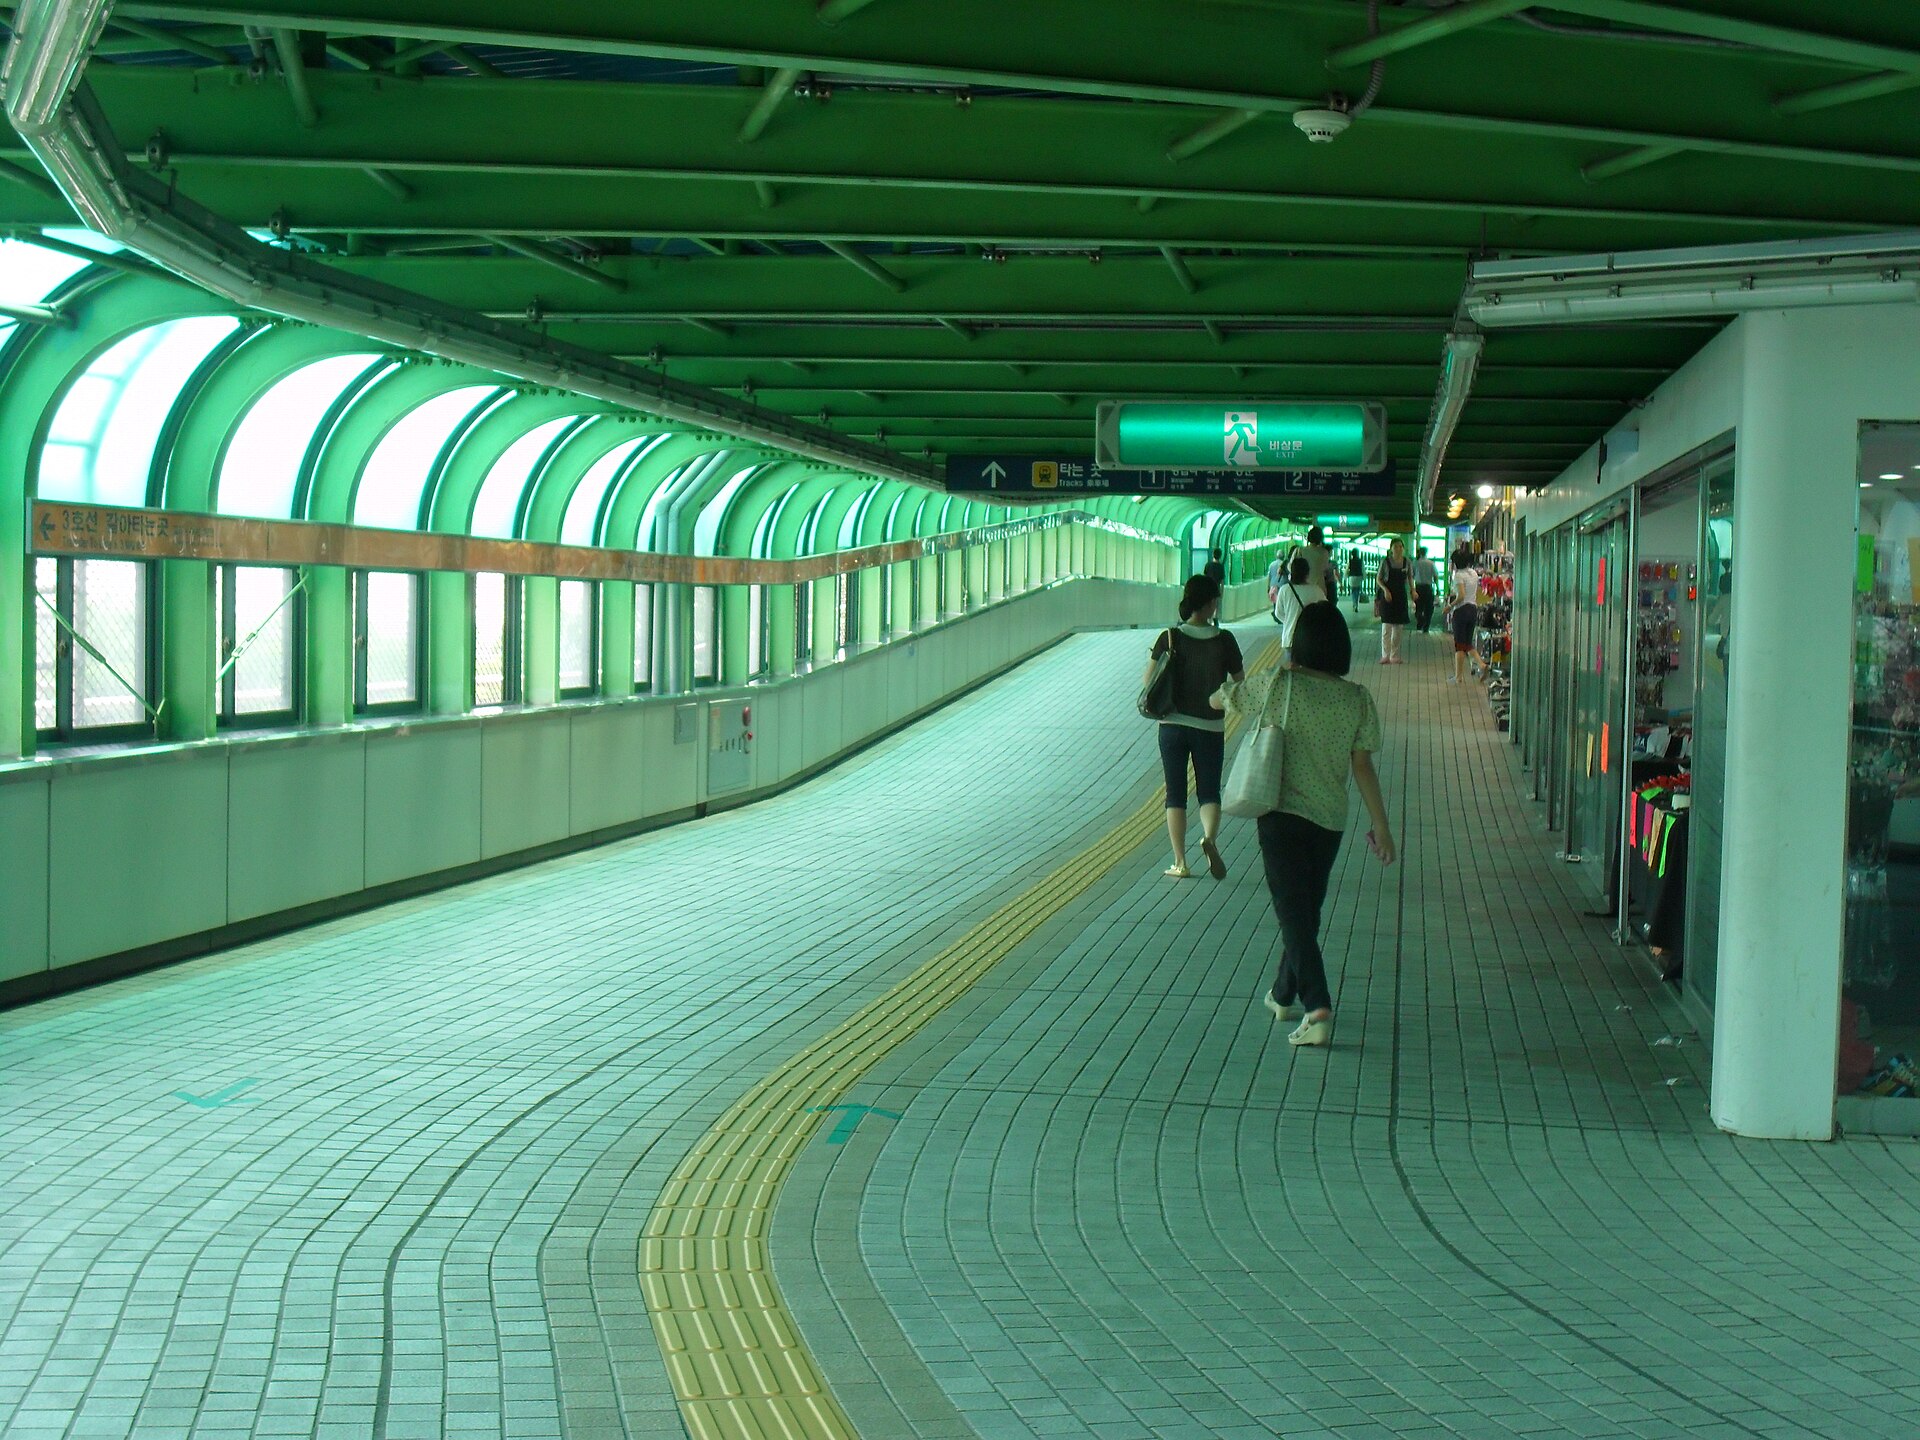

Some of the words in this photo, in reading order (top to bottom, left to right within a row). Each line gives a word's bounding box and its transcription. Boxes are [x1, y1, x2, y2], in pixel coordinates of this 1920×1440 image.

[1269, 440, 1302, 451] 비상문
[1060, 463, 1084, 477] 타는
[1090, 463, 1102, 477] 곳
[1060, 479, 1084, 487] Tracks
[1292, 471, 1303, 487] 2
[63, 509, 98, 533] 3호선
